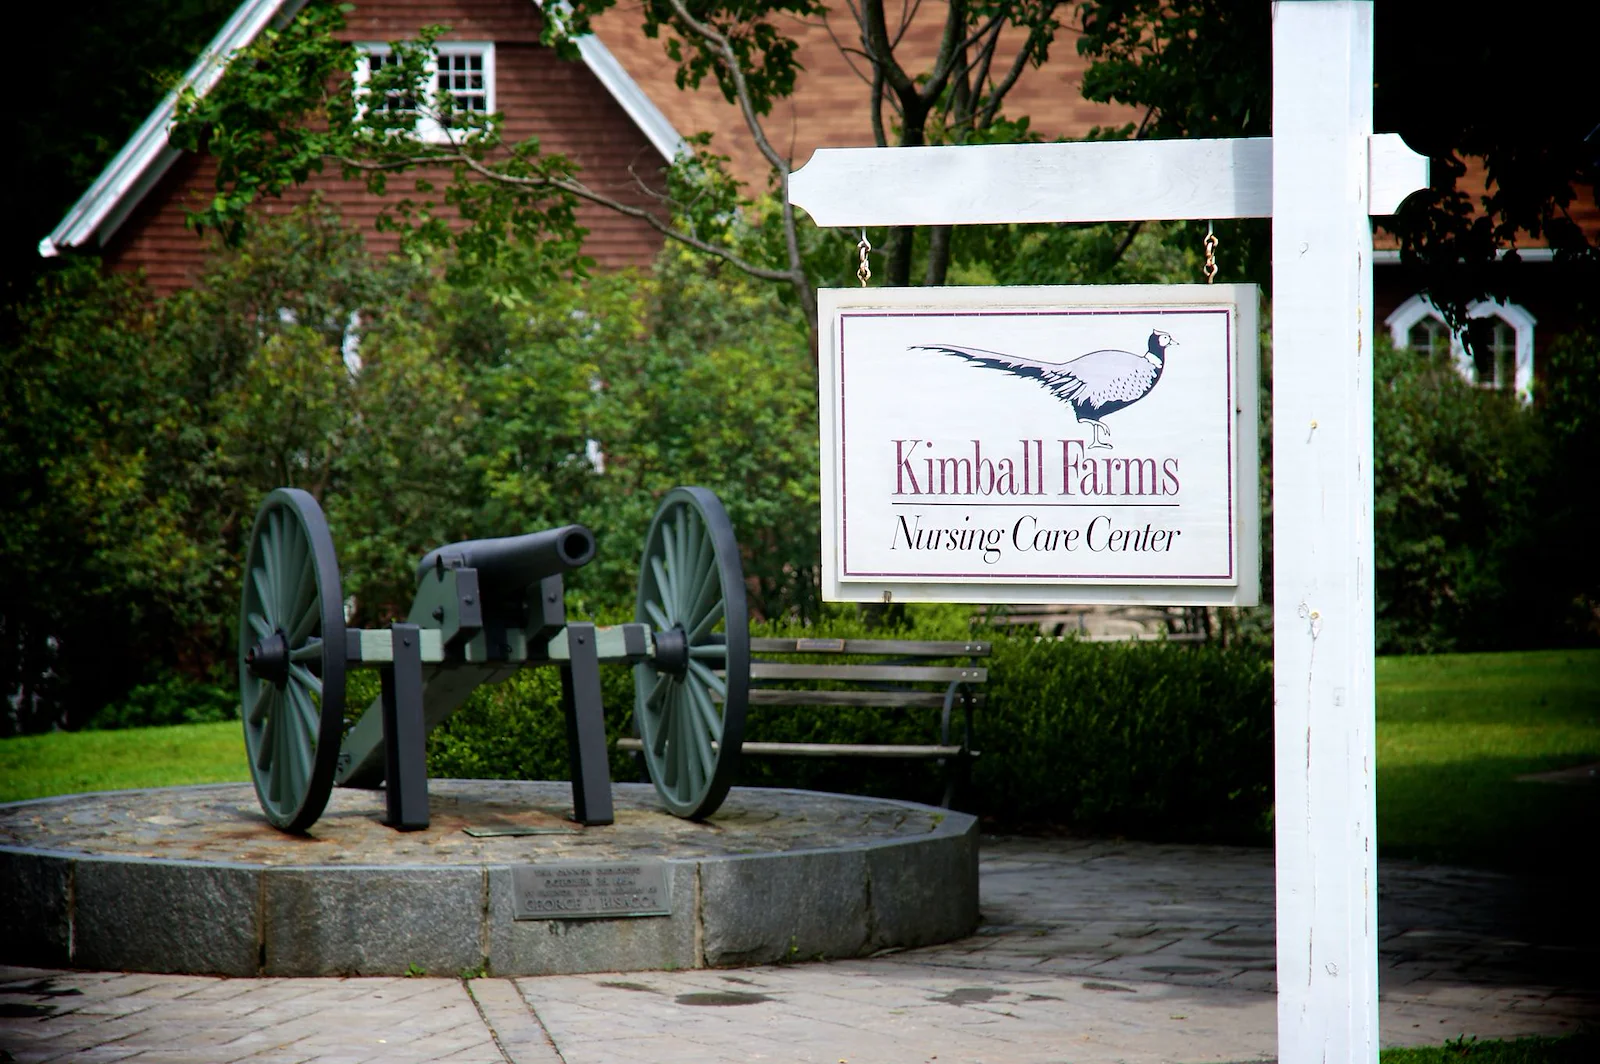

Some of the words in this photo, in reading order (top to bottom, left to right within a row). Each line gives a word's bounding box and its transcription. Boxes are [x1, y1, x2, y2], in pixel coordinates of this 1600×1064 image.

[891, 439, 1047, 496] Kimball
[1057, 439, 1180, 496] Farms
[891, 515, 1005, 564] Nursing
[1012, 515, 1079, 552] Care
[1086, 515, 1181, 552] Center
[524, 899, 582, 911] GEORGE
